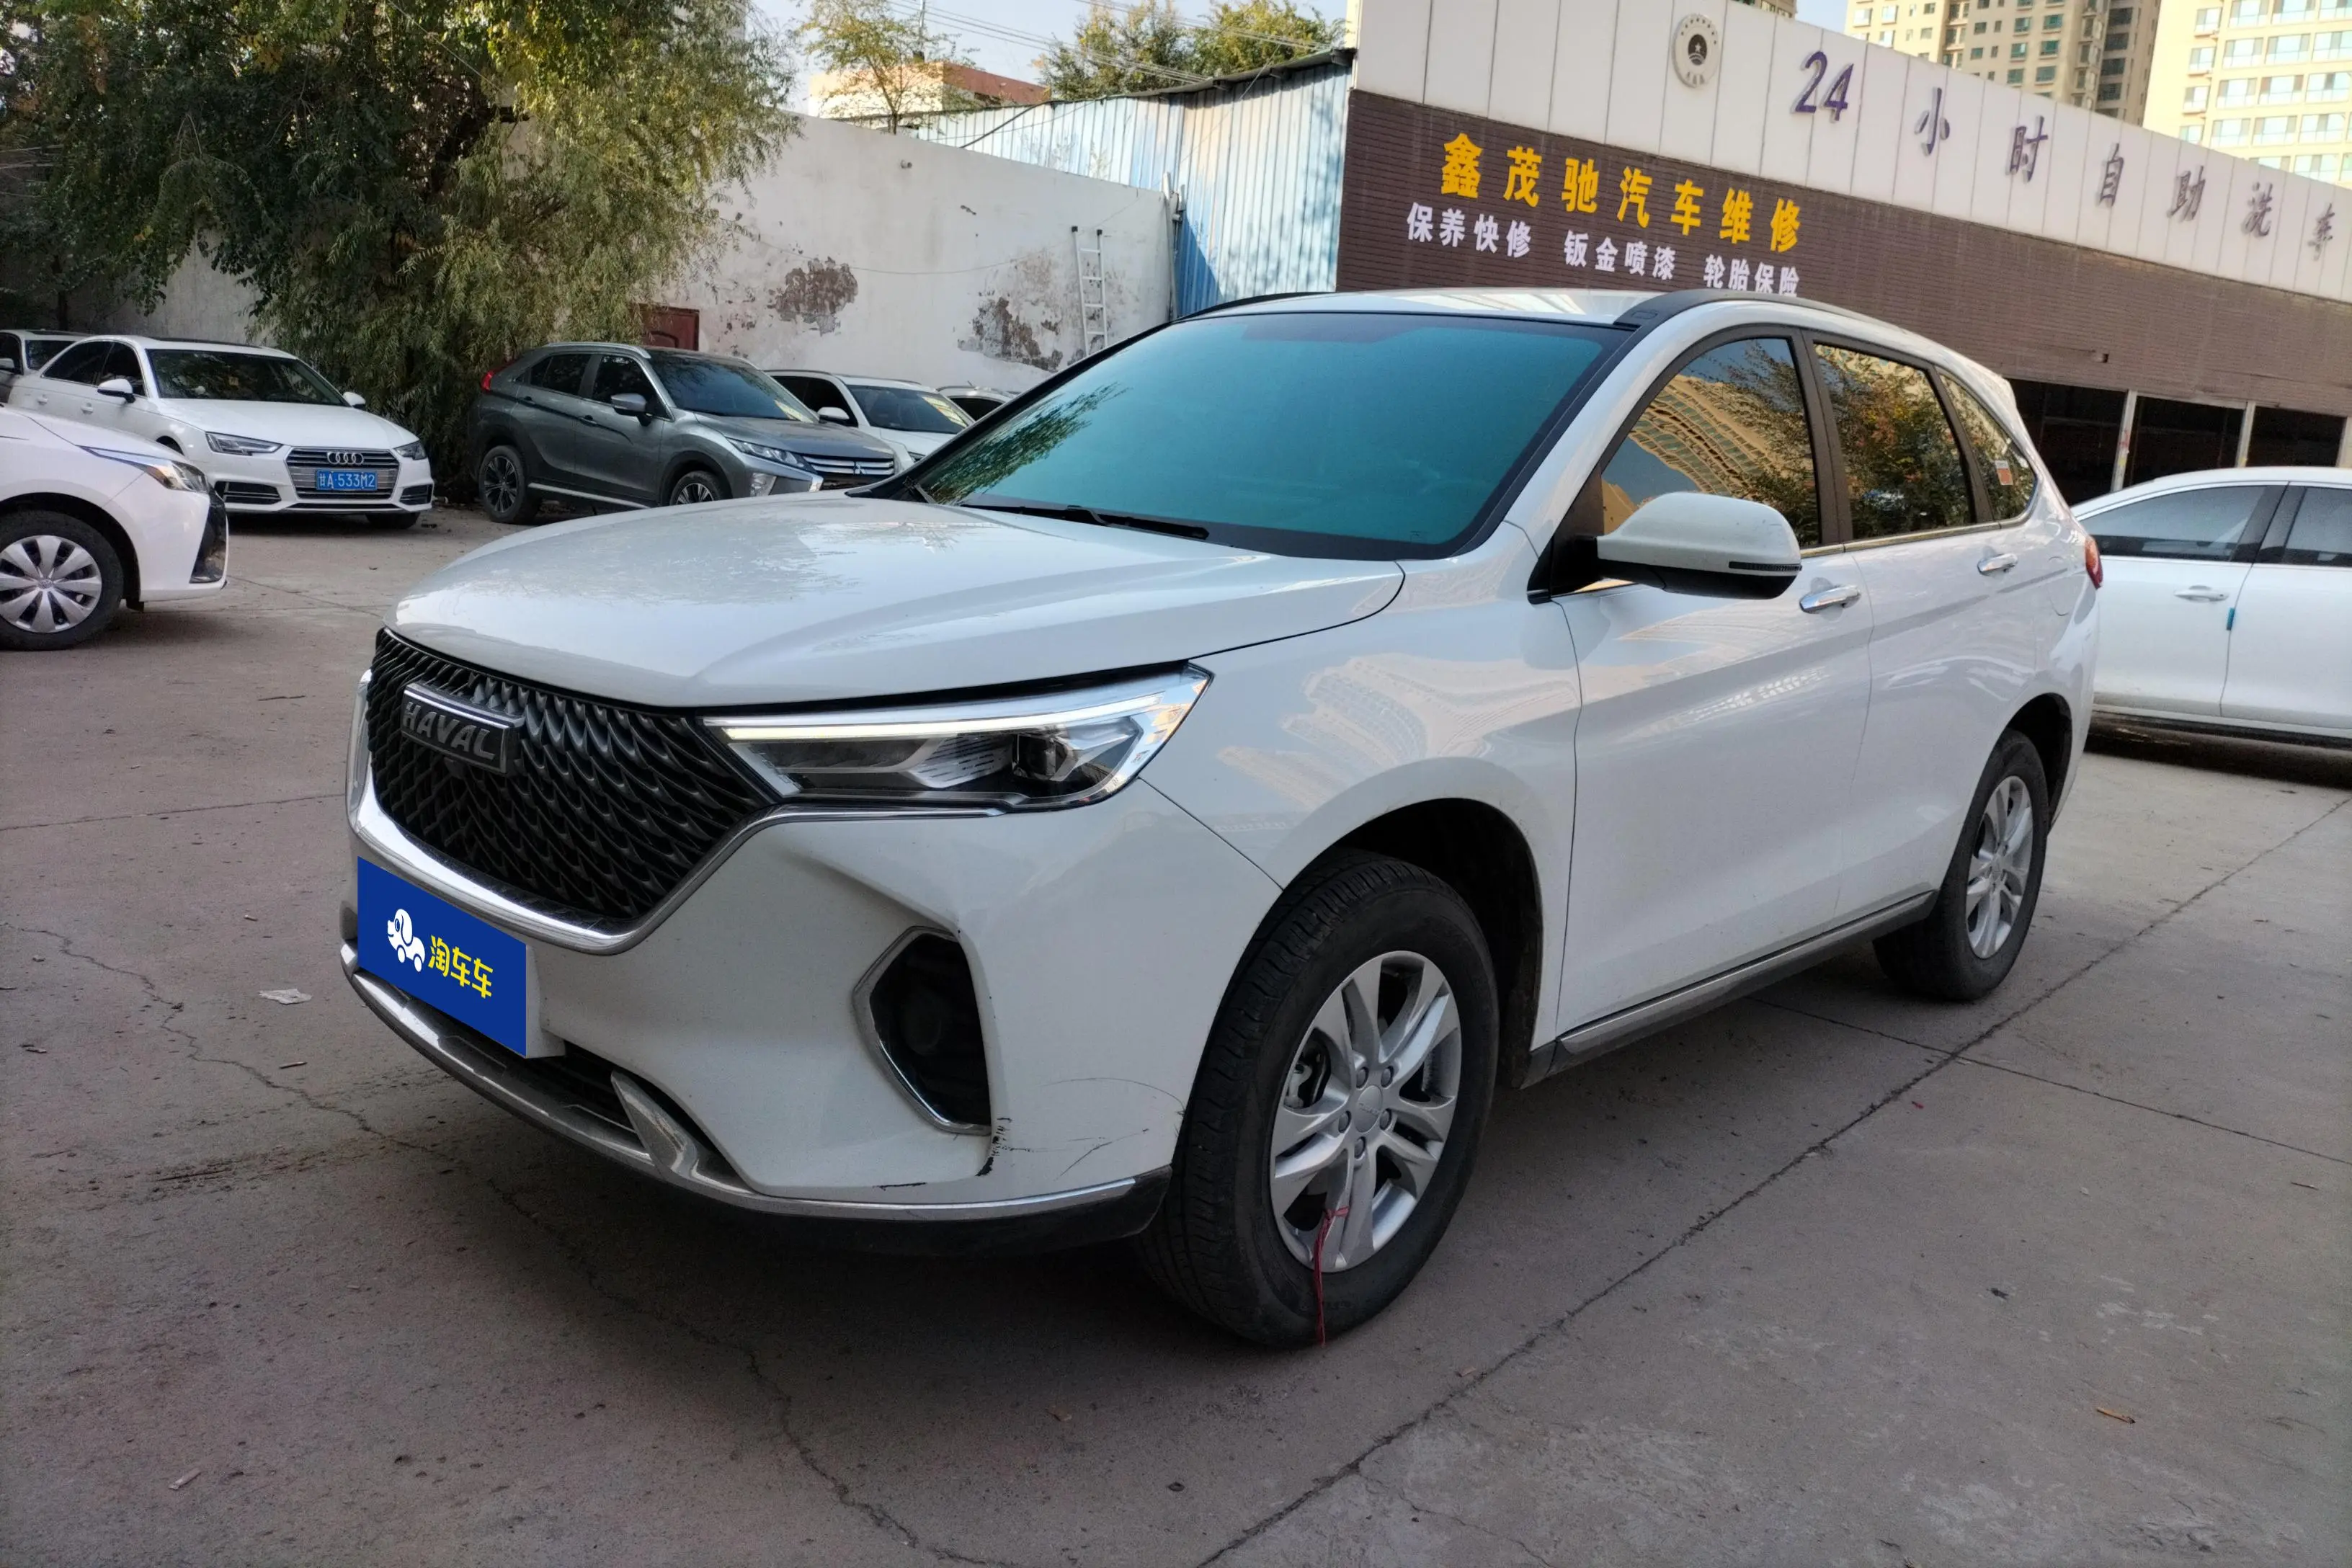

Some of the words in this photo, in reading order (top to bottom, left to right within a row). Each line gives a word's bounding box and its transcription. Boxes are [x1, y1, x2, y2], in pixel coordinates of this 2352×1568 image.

[1440, 133, 1801, 253] 鑫茂驰汽车维修
[1407, 201, 1531, 258] 保养快修
[1564, 230, 1676, 280] 钣金喷漆
[1703, 254, 1800, 297] 轮胎保险
[402, 701, 496, 761] HAVAL
